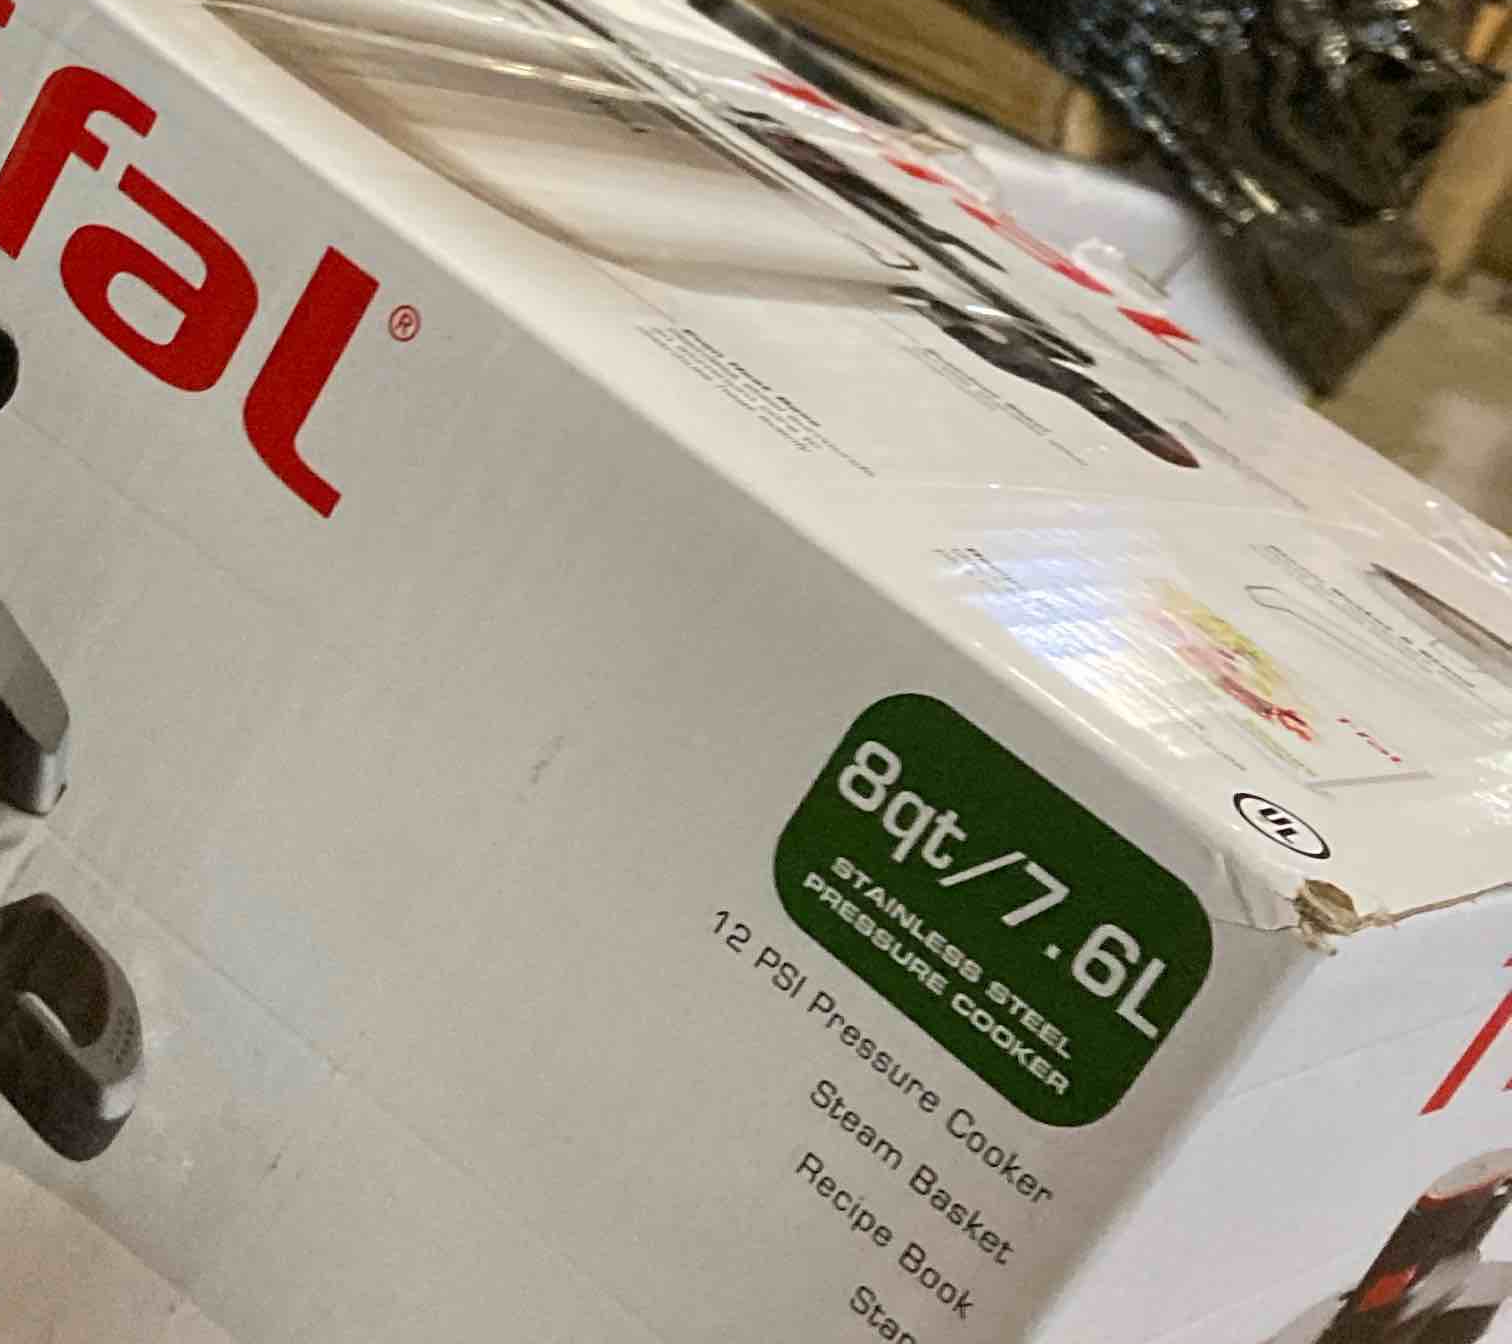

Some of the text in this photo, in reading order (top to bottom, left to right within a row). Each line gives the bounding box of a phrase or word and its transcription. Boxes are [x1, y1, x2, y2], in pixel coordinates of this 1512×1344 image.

[799, 869, 1073, 1099] PRESSURE COOKER
[826, 853, 1079, 1062] STAINLESS STEEL
[837, 739, 1159, 1039] 8qt/7.6L
[711, 910, 1058, 1212] 12 PSI Pressure Cooker
[792, 1149, 980, 1322] Recipe Book
[805, 1075, 1021, 1268] Steam Basket
